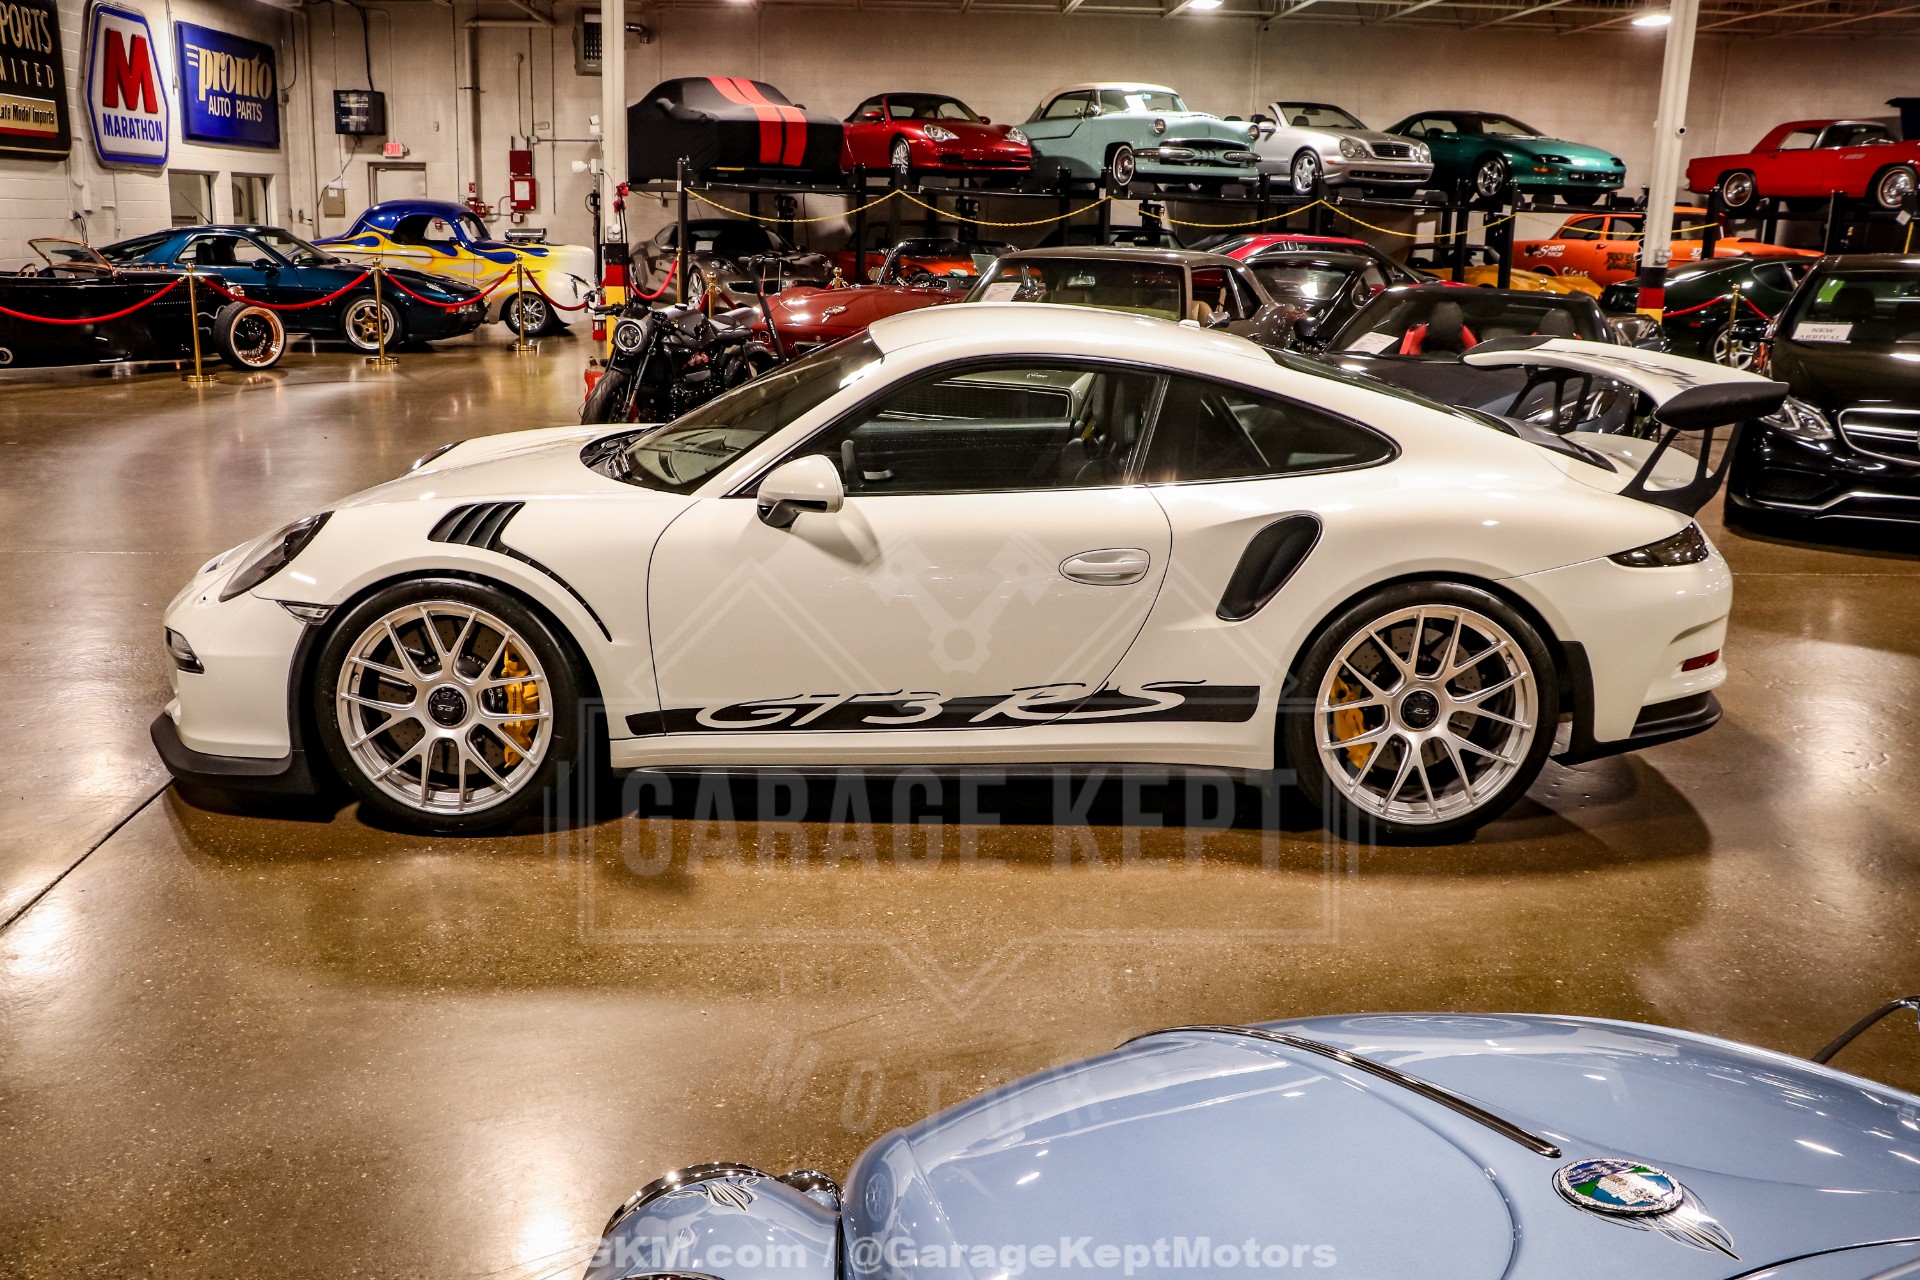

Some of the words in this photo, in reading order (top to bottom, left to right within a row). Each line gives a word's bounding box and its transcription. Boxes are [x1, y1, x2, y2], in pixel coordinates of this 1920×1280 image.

[103, 27, 158, 113] M
[197, 47, 273, 101] pronto
[0, 102, 10, 120] ate
[12, 103, 31, 122] Model
[32, 105, 55, 126] Imports
[208, 94, 231, 118] AUTO
[236, 100, 262, 123] PARTS
[103, 113, 163, 142] MARATHON
[386, 143, 400, 155] EXIT
[695, 689, 943, 729] GT3
[968, 680, 1207, 723] RS
